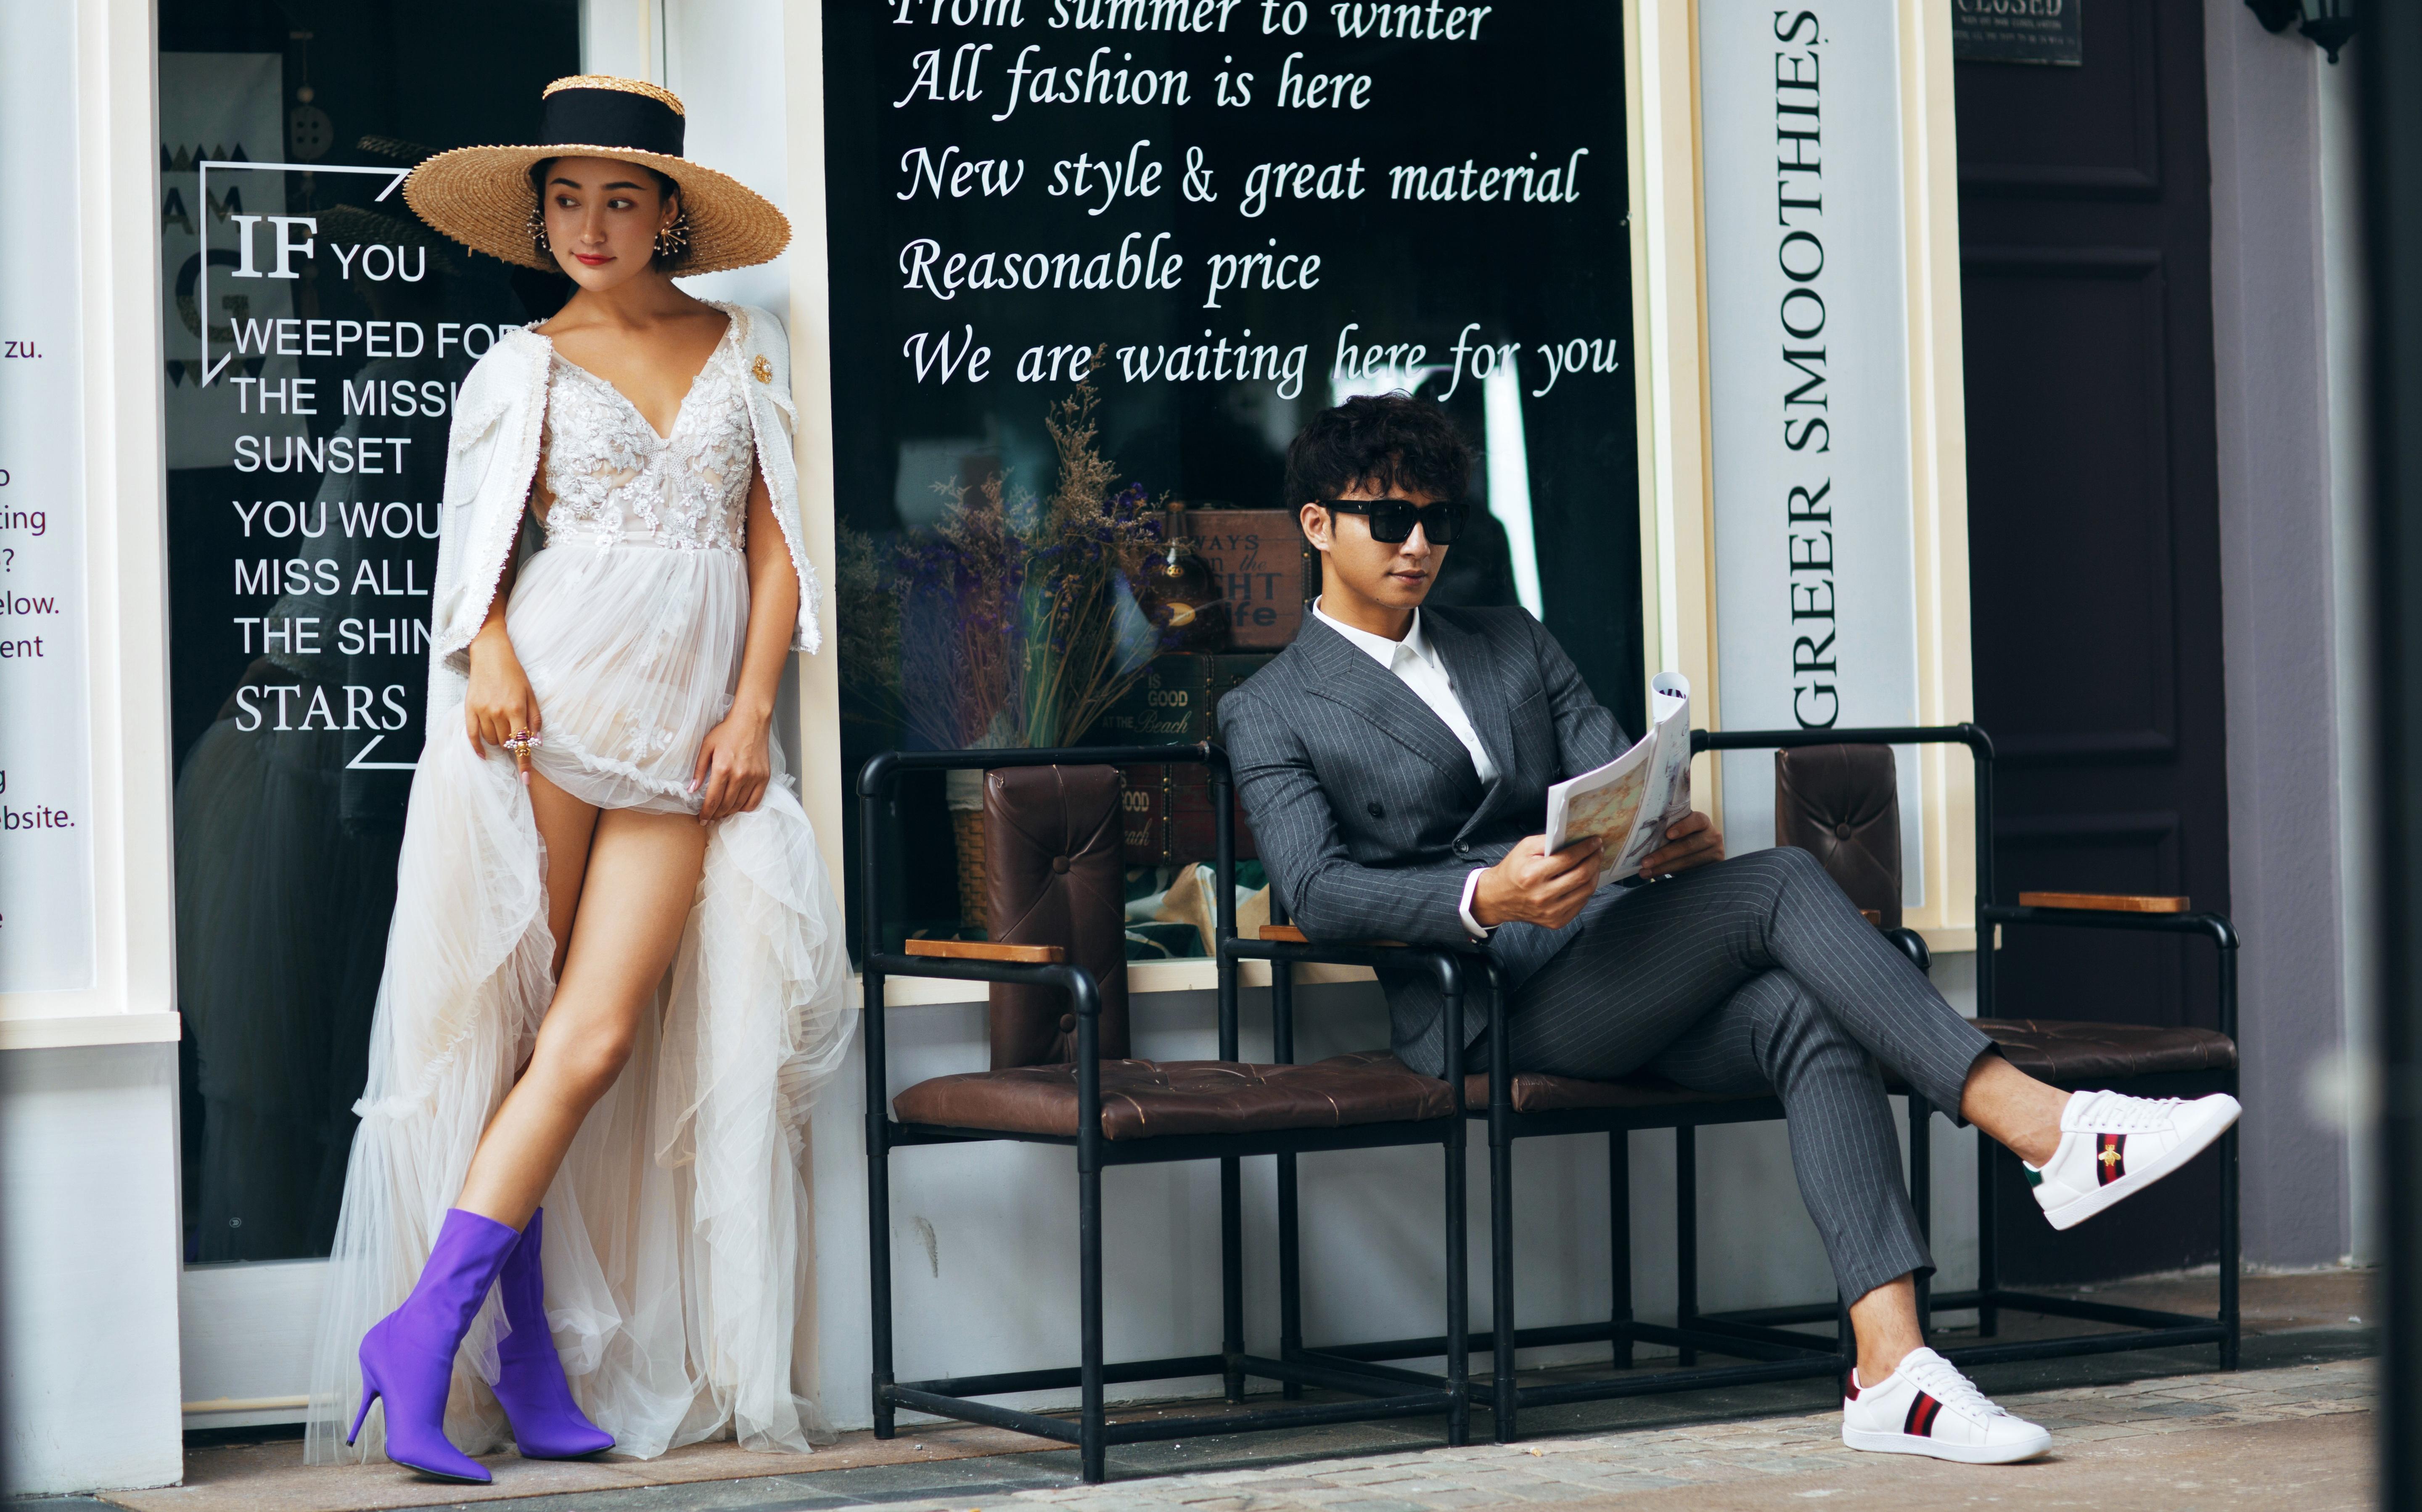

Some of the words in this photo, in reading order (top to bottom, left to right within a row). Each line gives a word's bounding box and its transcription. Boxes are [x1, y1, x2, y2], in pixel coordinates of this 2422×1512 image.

[888, 0, 1025, 27] From
[1048, 0, 1241, 32] summer
[1261, 0, 1307, 35] to
[1330, 0, 1492, 40] winter
[893, 43, 993, 108] All
[992, 44, 1191, 122] fashion
[1214, 55, 1254, 107] is
[1277, 52, 1372, 109] here
[896, 146, 1024, 200] New
[1047, 140, 1162, 216] style
[1182, 146, 1217, 202] &
[1240, 157, 1365, 217] great
[1389, 148, 1589, 203] material
[231, 215, 317, 279] IF
[331, 243, 425, 282] YOU
[1774, 11, 1830, 454] SMOOTHIES
[899, 232, 1183, 300] Reasonable
[1203, 238, 1321, 308] price
[231, 317, 424, 358] WEEPED
[903, 324, 991, 385] We
[1016, 344, 1092, 382] are
[1116, 329, 1308, 400] waiting
[1332, 323, 1427, 380] here
[1437, 323, 1521, 402] for
[1532, 338, 1618, 397] you
[230, 377, 317, 415] THE
[233, 435, 411, 474] SUNSET
[232, 501, 326, 538] YOU
[338, 502, 442, 539] WOU
[235, 558, 340, 596] MISS
[350, 559, 428, 595] ALL
[1788, 476, 1839, 729] GREER
[233, 617, 321, 654] THE
[1148, 674, 1162, 689] IS
[1148, 690, 1188, 707] GOOD
[235, 684, 407, 732] STARS
[1102, 716, 1114, 728] AT
[1116, 716, 1134, 729] THE
[1134, 709, 1192, 734] Beach
[0, 804, 75, 830] bsite.
[1122, 790, 1150, 812] OOD
